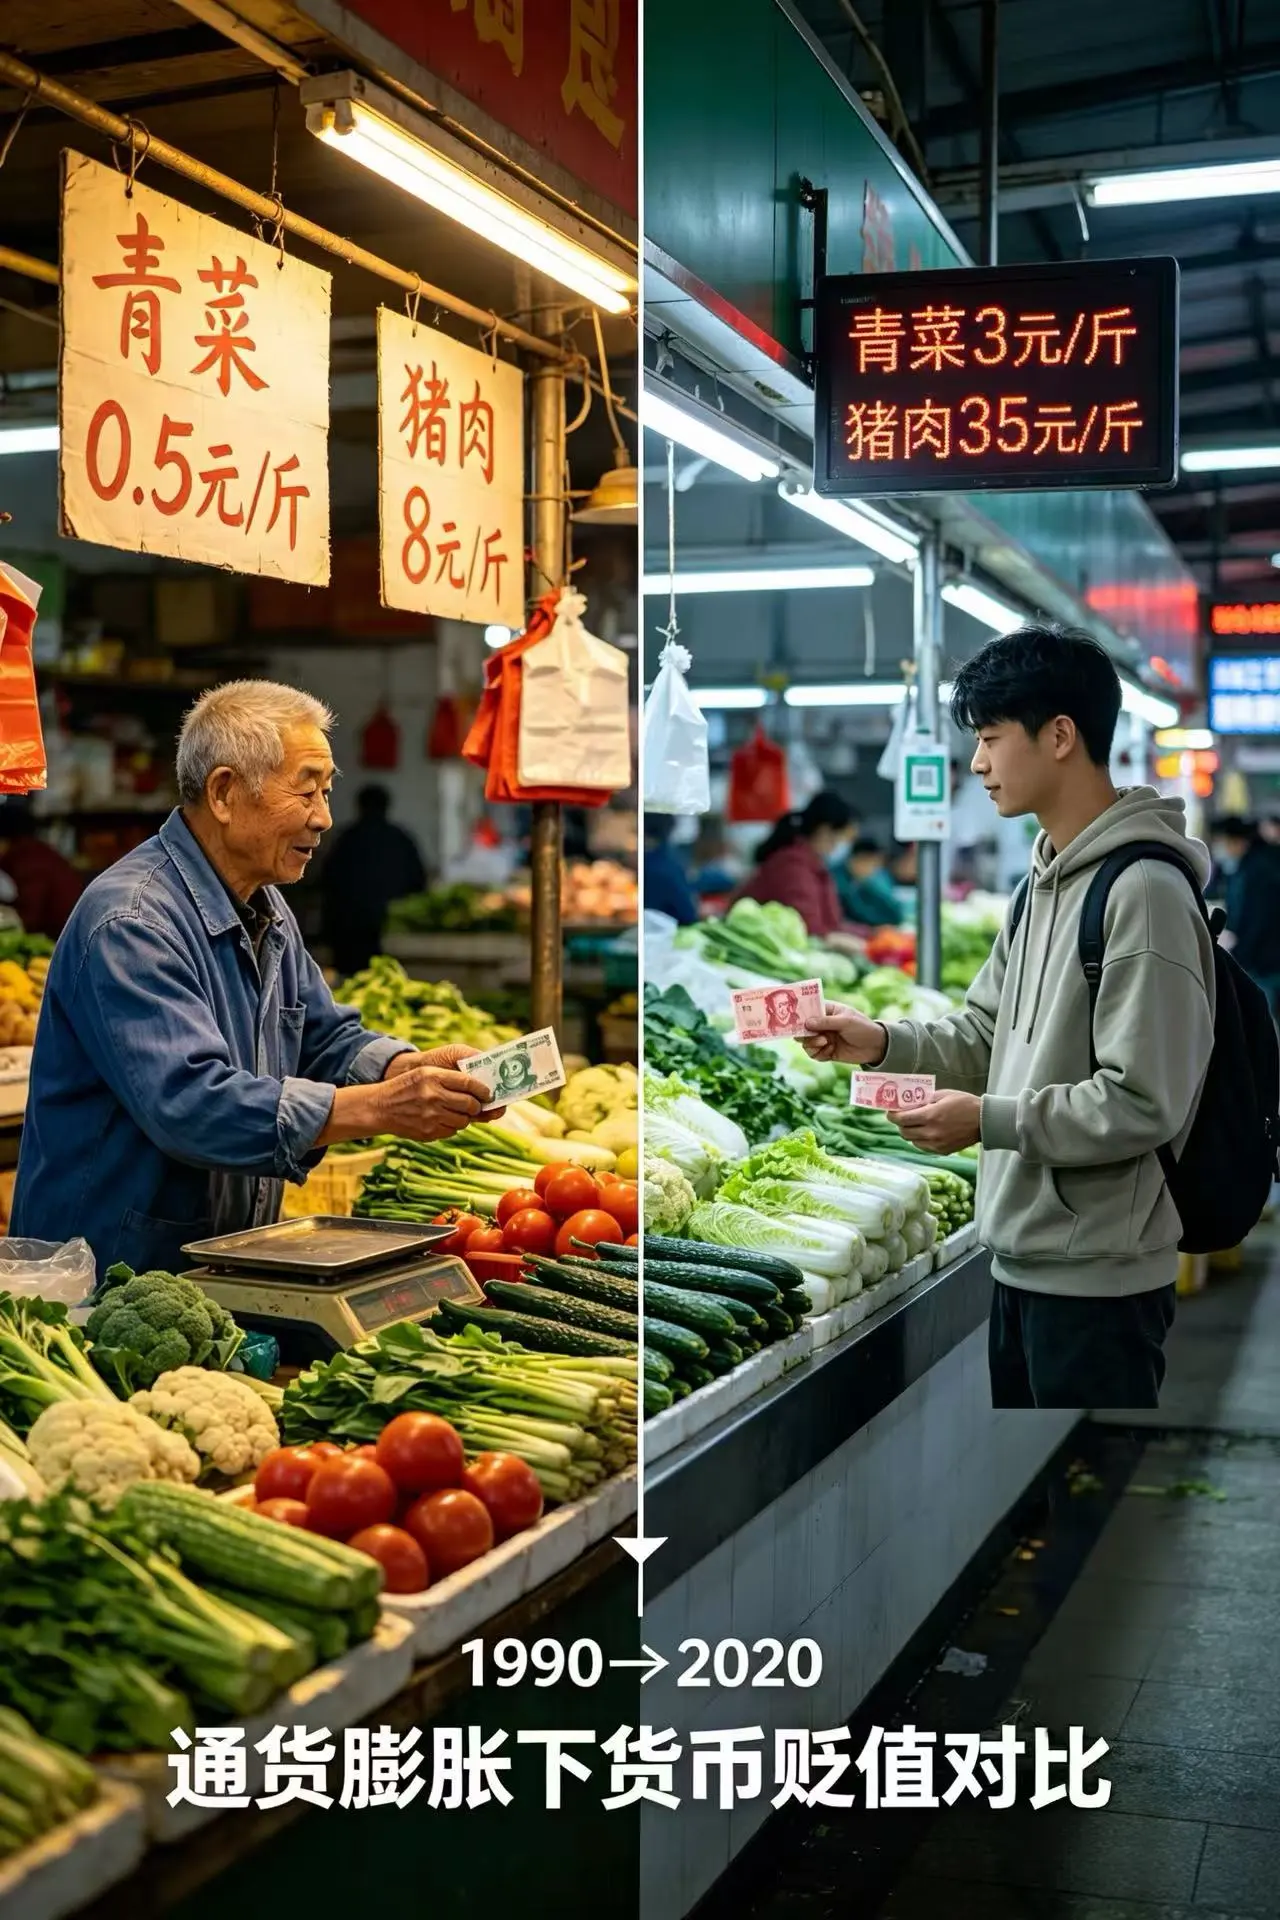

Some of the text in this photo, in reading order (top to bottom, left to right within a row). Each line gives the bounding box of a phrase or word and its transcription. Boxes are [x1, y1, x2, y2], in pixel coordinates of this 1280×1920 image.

[92, 213, 270, 397] 青菜
[848, 305, 1138, 375] 青菜3元/斤
[85, 398, 311, 552] 0.5元/斤
[399, 360, 496, 485] 猪肉
[844, 395, 1144, 461] 猪肉35元/斤
[400, 485, 510, 605] 8元/斤
